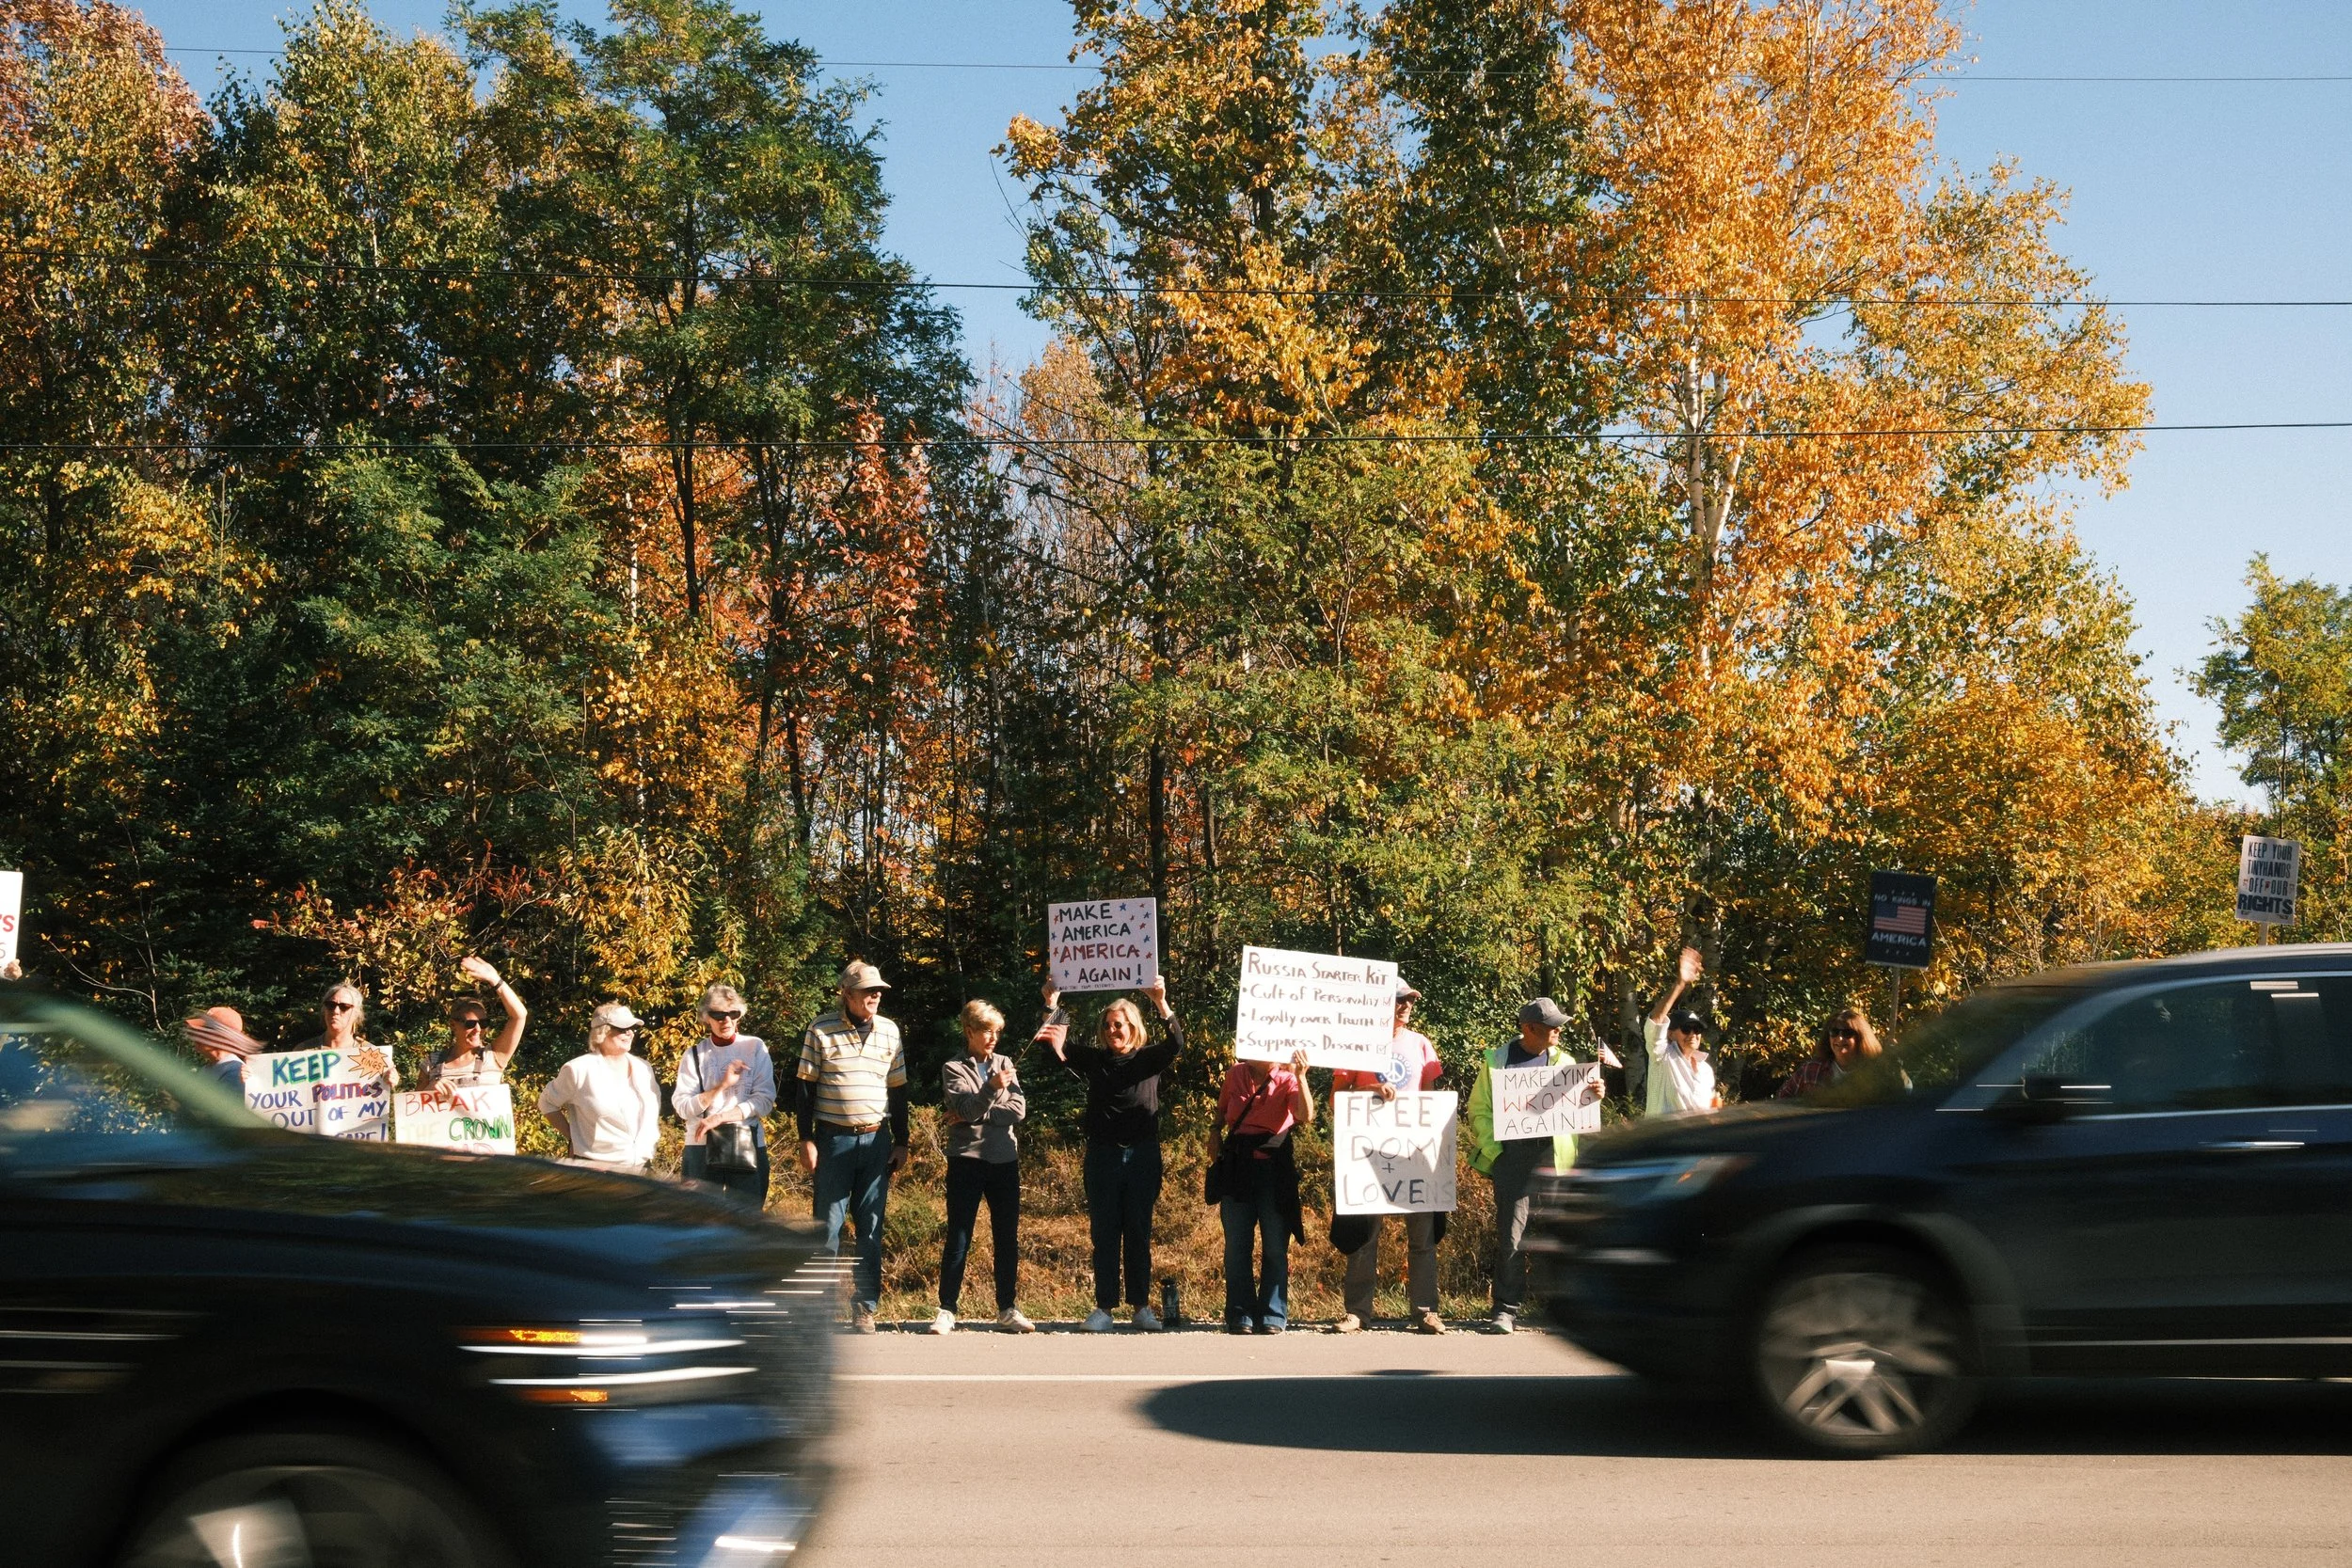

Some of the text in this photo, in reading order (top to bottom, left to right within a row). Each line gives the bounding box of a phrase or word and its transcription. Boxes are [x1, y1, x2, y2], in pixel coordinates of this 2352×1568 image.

[2248, 841, 2293, 861] KEEP YOUR
[2249, 878, 2288, 896] OFF OUR
[1874, 894, 1887, 902] NO
[2237, 894, 2294, 915] RIGHTS
[1058, 902, 1113, 923] MAKE
[1061, 923, 1131, 943] AMERICA
[1871, 931, 1927, 947] AMERICA
[1059, 942, 1140, 963] AMERICA
[1290, 986, 1308, 1001] of
[272, 1051, 342, 1087] KEEP
[1504, 1067, 1596, 1090] MAKE LYING
[248, 1089, 303, 1110] YOUR
[405, 1091, 491, 1117] BREAK
[1503, 1089, 1592, 1113] WRONG
[271, 1101, 388, 1130] OUT OF MY
[1347, 1095, 1434, 1128] FREE
[449, 1114, 512, 1141] CROWN
[1351, 1135, 1438, 1162] DOM
[1343, 1174, 1425, 1206] LOVE
